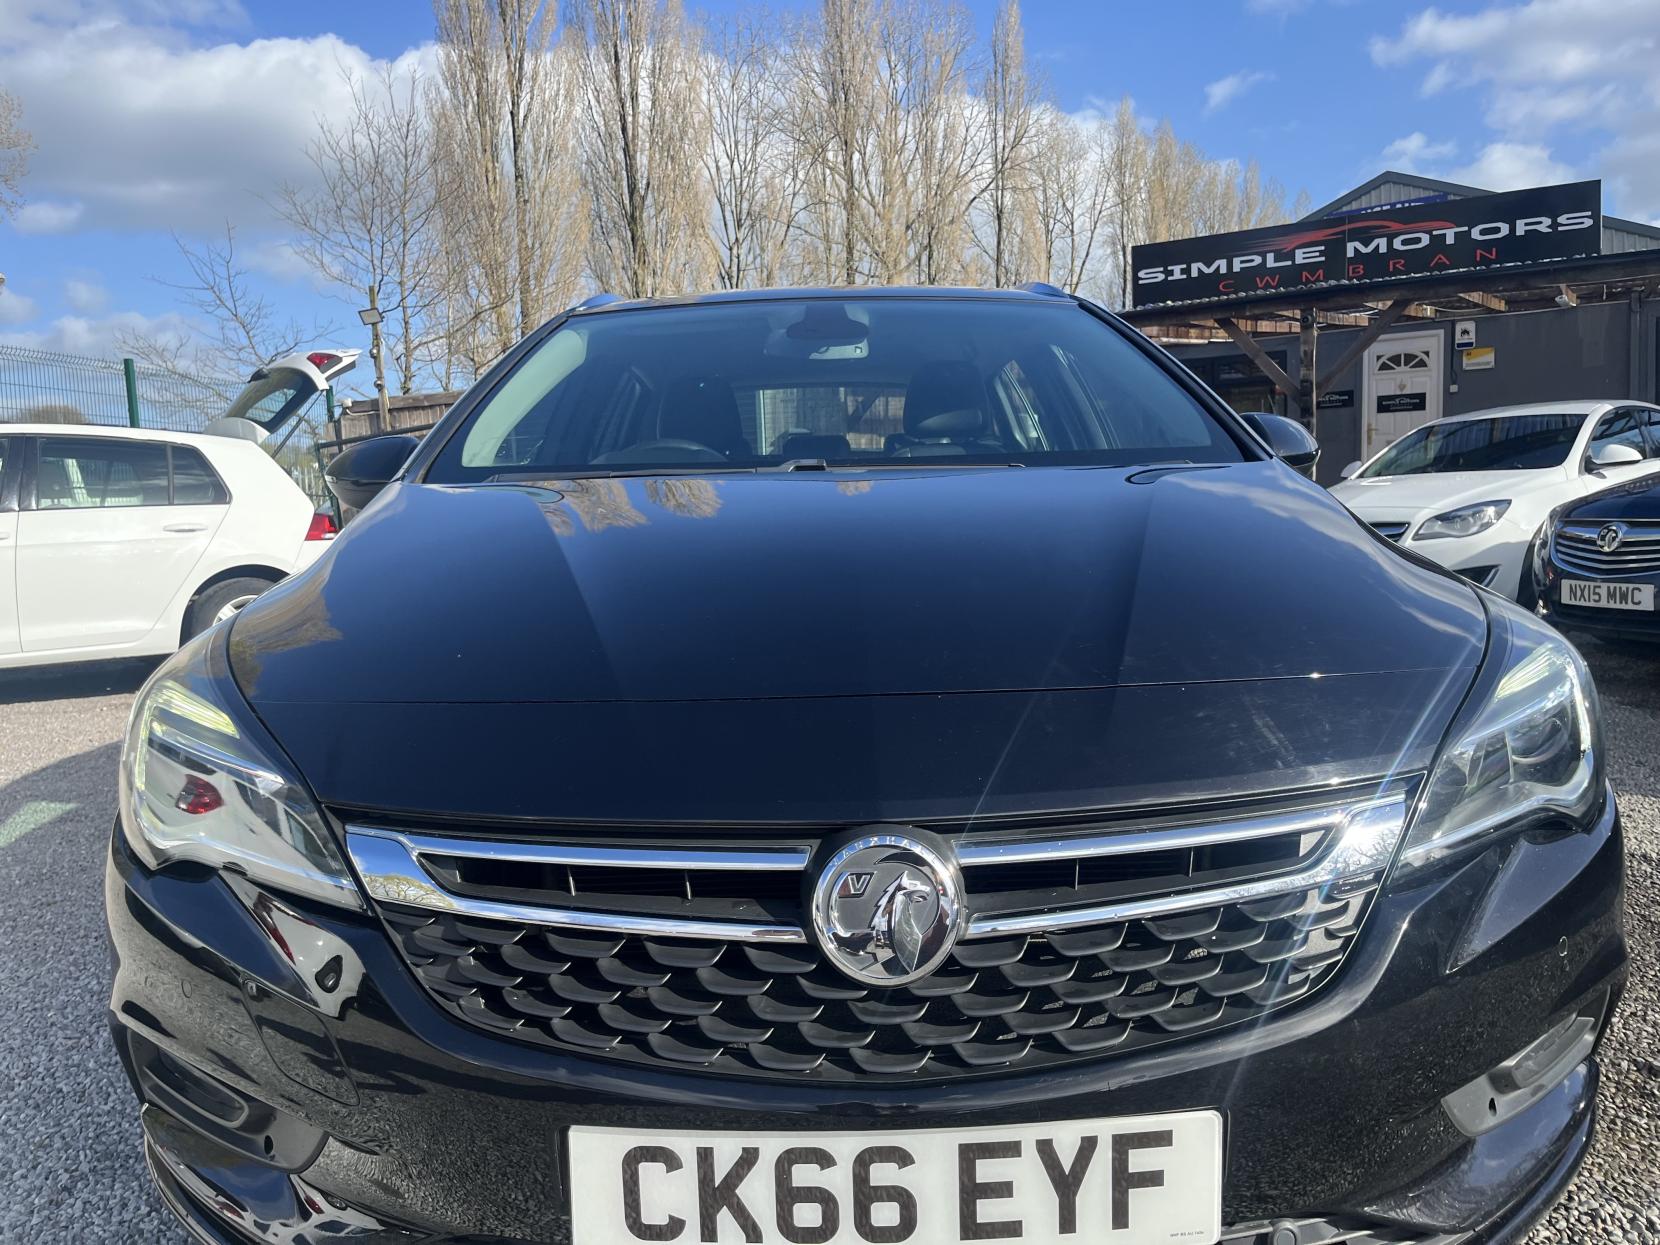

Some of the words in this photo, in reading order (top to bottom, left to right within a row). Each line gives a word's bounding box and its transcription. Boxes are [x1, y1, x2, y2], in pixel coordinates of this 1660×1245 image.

[1137, 245, 1326, 285] SIMPLE
[1346, 210, 1594, 258] MOTORS
[1218, 247, 1497, 293] CWMBRAN
[1569, 583, 1602, 603] NX15
[1606, 585, 1642, 606] MWC
[621, 1145, 918, 1244] CK66
[957, 1129, 1174, 1241] EYF
